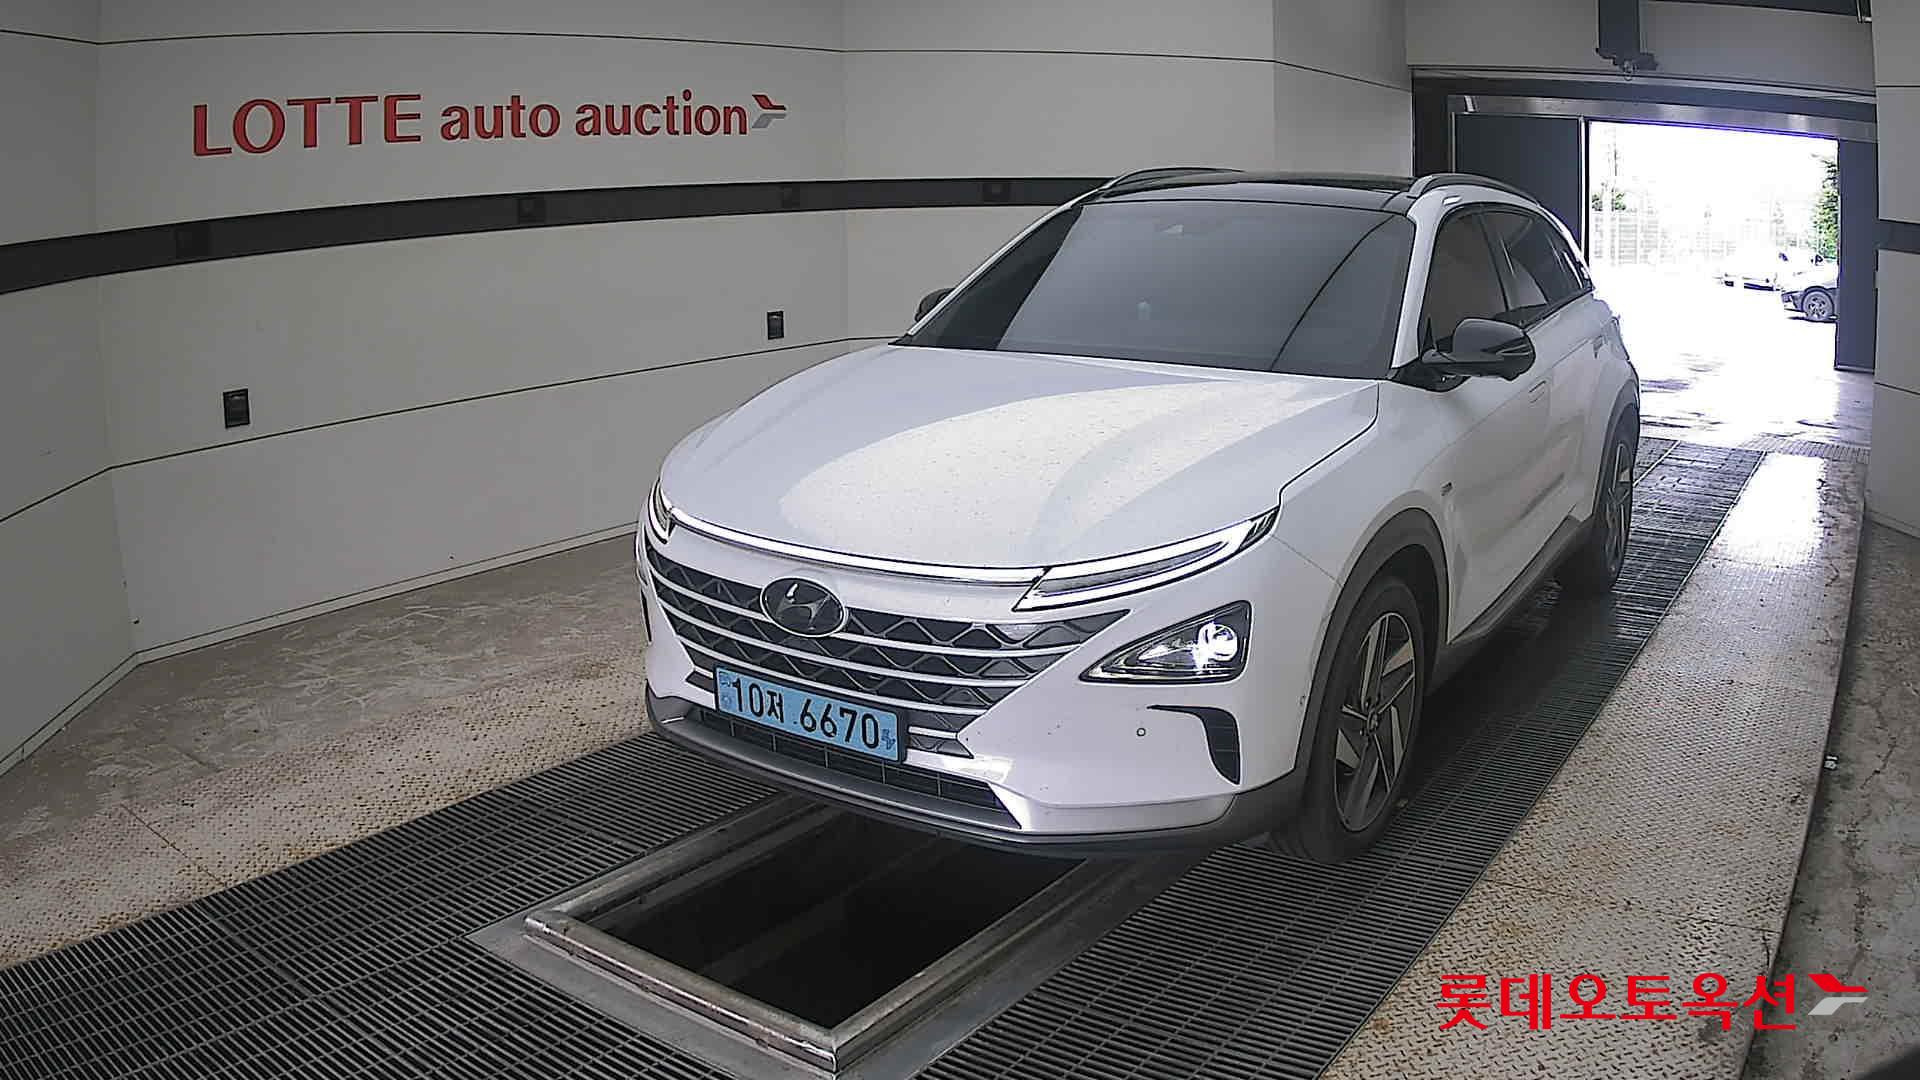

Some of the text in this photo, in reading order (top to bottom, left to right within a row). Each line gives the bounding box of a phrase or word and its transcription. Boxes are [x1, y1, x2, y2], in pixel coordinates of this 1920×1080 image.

[193, 89, 748, 157] LOTTE auto auction
[732, 678, 879, 749] 10저 6670
